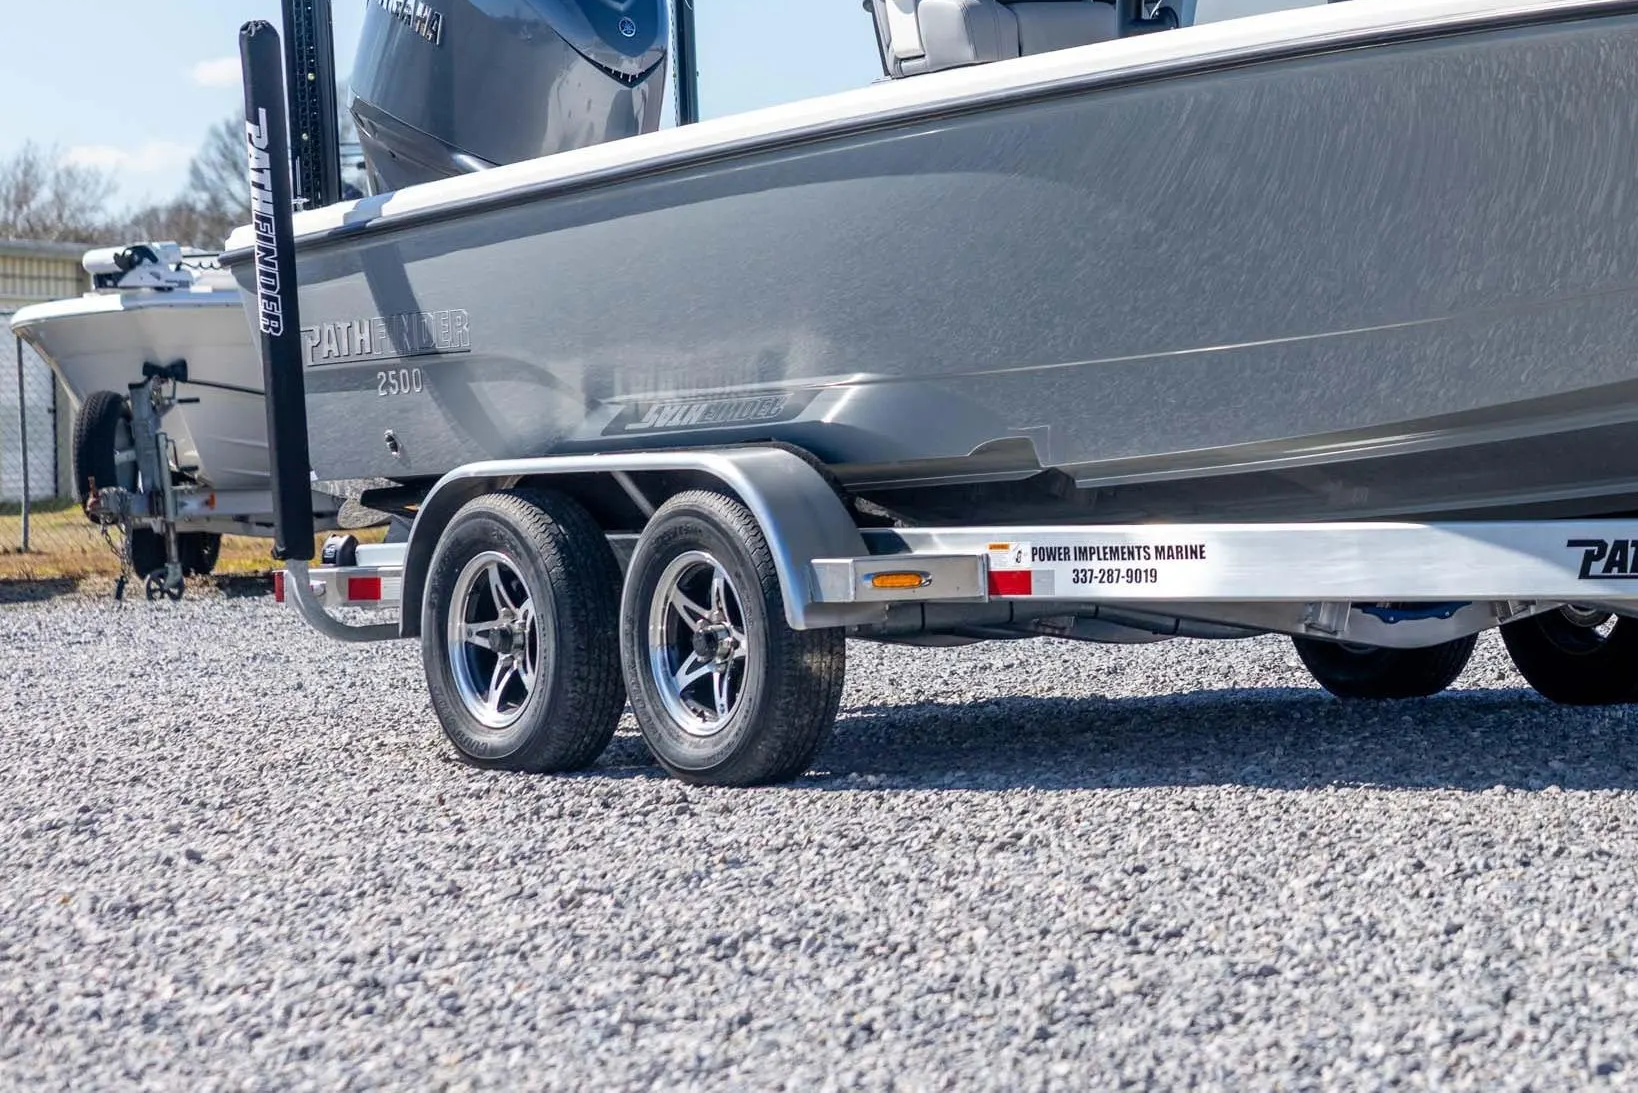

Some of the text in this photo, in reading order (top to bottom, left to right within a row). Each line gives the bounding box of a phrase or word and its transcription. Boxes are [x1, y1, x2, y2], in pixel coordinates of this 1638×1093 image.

[245, 107, 284, 337] PATHFINDER
[300, 309, 472, 367] PATHFINDER
[377, 368, 423, 396] 2500
[1031, 546, 1071, 562] POWER
[1074, 545, 1151, 562] IMPLEMENTS
[1155, 544, 1206, 560] MARINE
[1072, 568, 1158, 584] 337-287-9019
